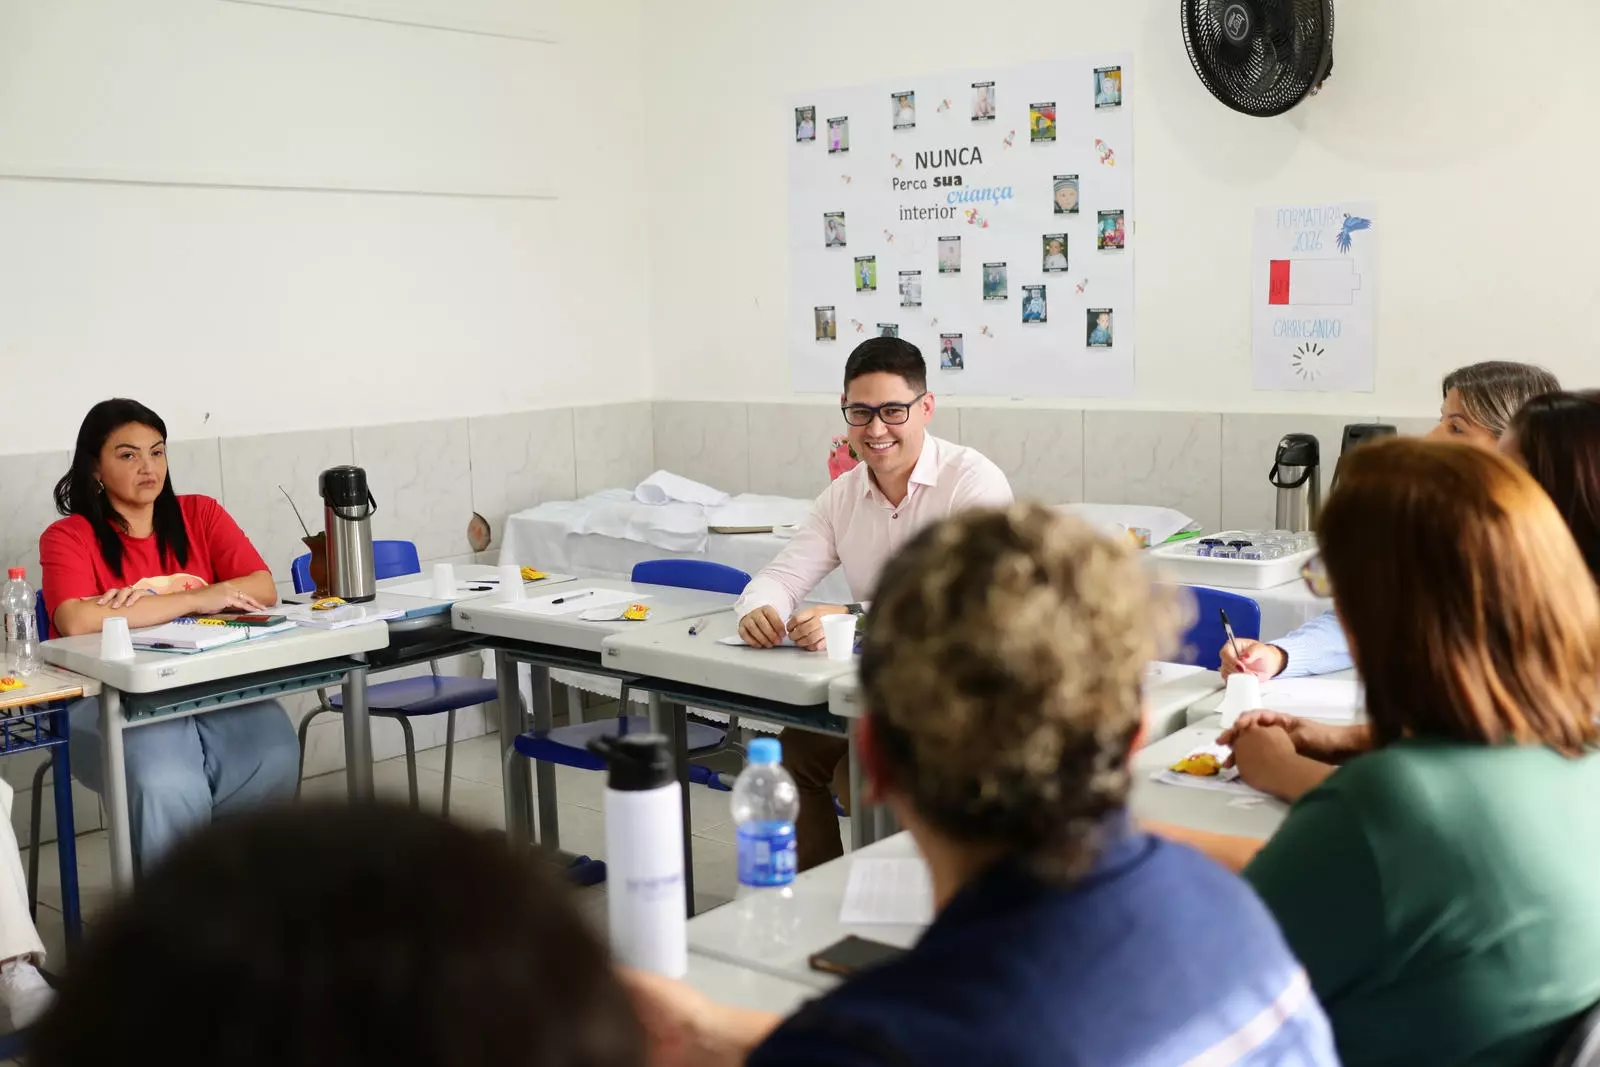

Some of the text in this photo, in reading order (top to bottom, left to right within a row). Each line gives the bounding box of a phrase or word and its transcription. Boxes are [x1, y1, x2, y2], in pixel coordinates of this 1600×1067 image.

[915, 146, 983, 170] NUNCA
[892, 175, 963, 191] Perca sua
[946, 185, 1014, 206] criança
[899, 203, 957, 221] interior
